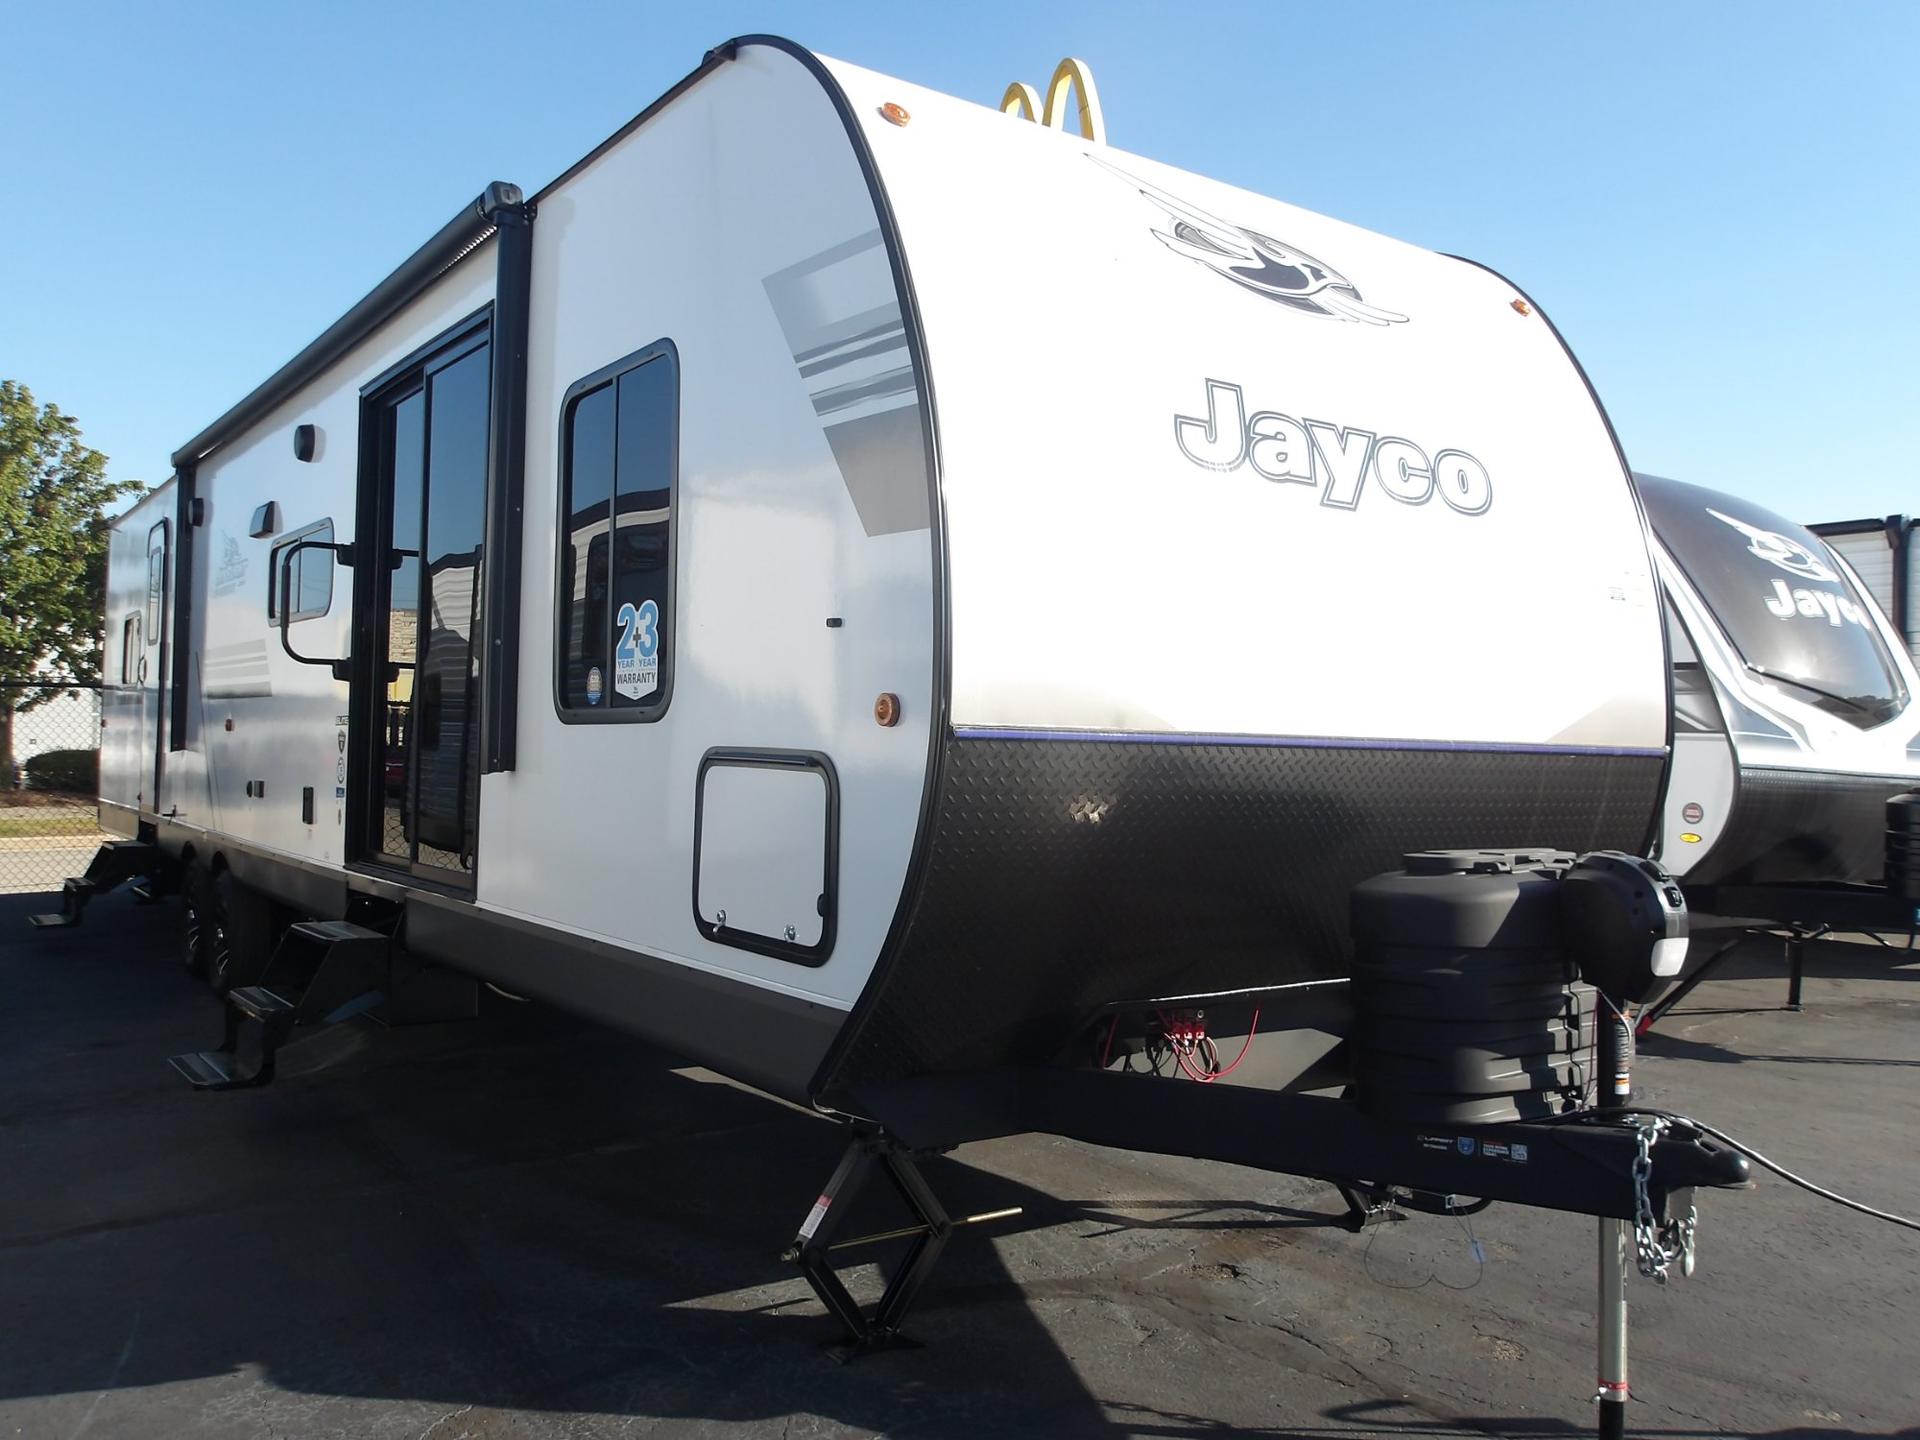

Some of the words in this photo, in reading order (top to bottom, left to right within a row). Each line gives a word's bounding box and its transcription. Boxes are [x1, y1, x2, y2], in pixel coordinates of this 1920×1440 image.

[1174, 378, 1493, 517] Jayco
[618, 660, 635, 669] YEAR
[638, 657, 656, 667] YEAR
[616, 672, 656, 685] WARRANTY
